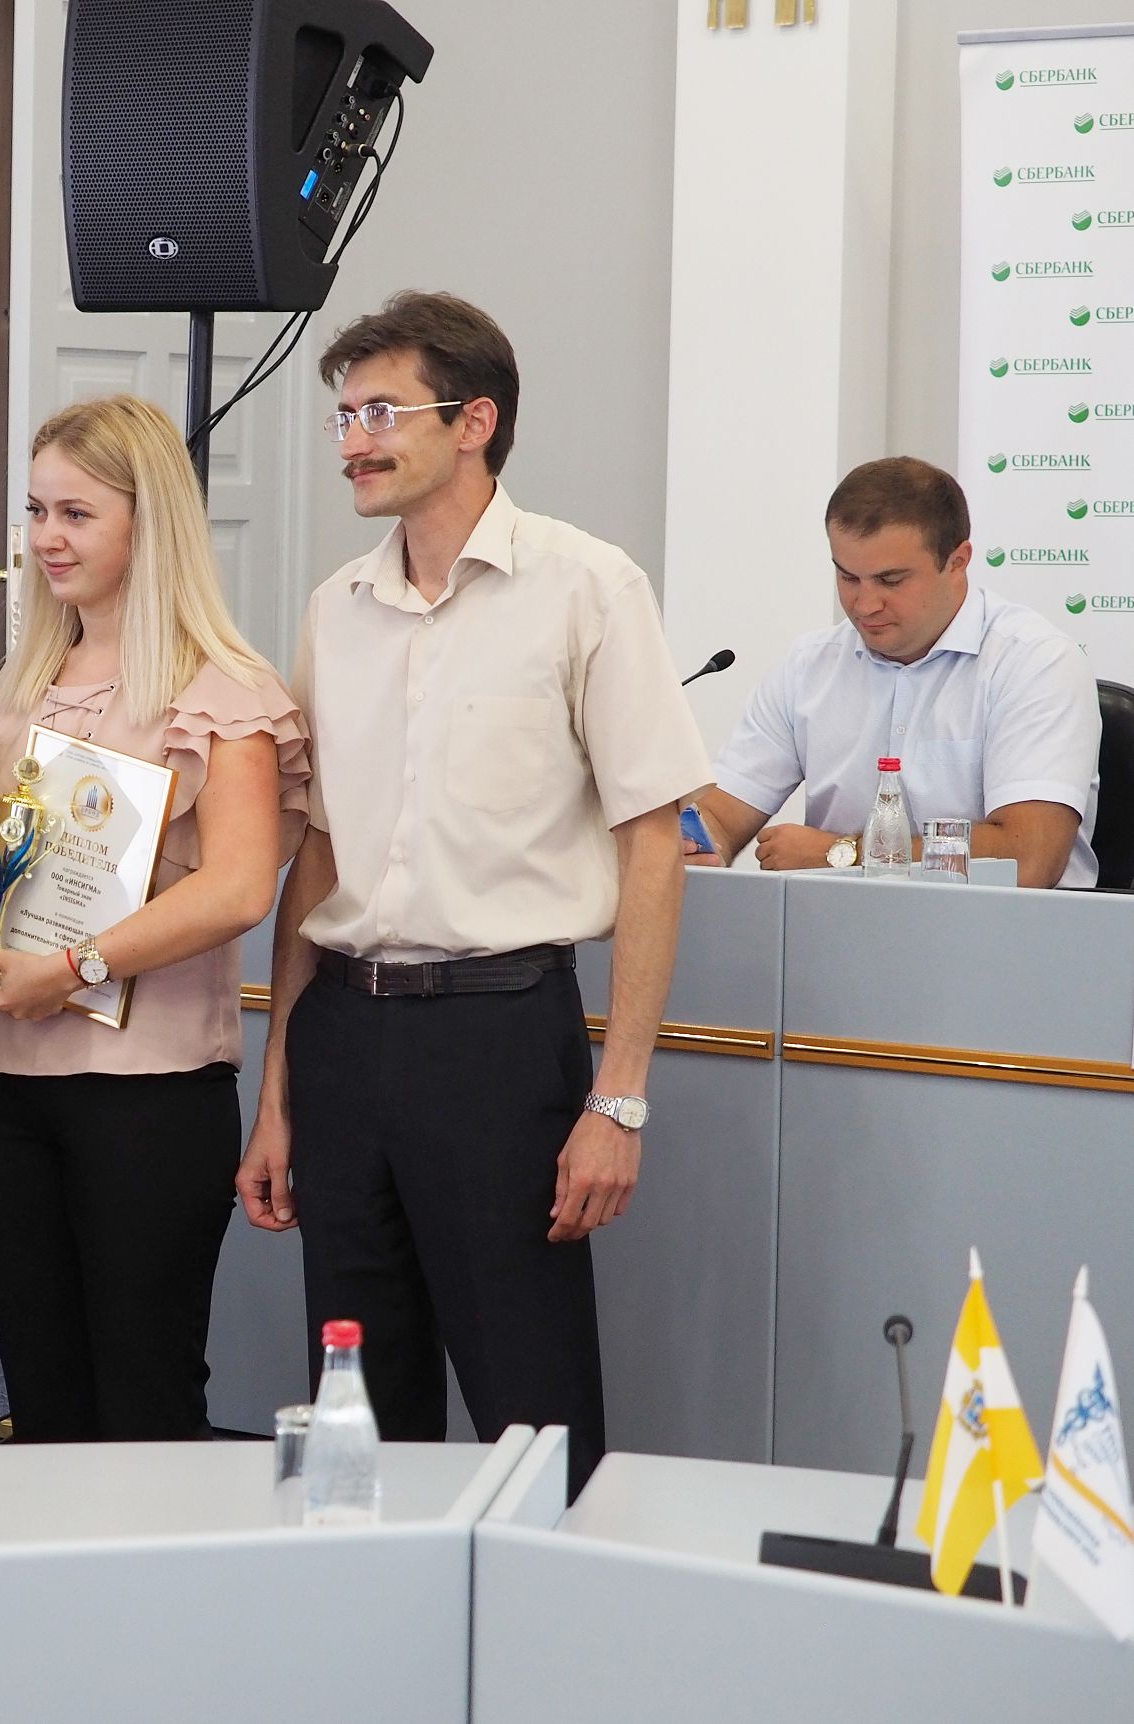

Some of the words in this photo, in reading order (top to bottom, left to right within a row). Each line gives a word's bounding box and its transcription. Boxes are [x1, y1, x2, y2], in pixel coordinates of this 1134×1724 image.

[1018, 67, 1098, 84] СБЕРБАНК
[1016, 165, 1096, 181] СБЕРБАНК
[1015, 260, 1094, 275] СБЕРБАНК
[1013, 357, 1093, 372] СБЕРБАНК
[1094, 403, 1134, 417] СБЕР
[1011, 454, 1091, 468] СБЕРБАНК
[1009, 548, 1090, 562] СБЕРБАНК
[59, 831, 109, 857] ДИПЛОМ
[44, 841, 119, 875] ПОБЕДИТЕЛЯ
